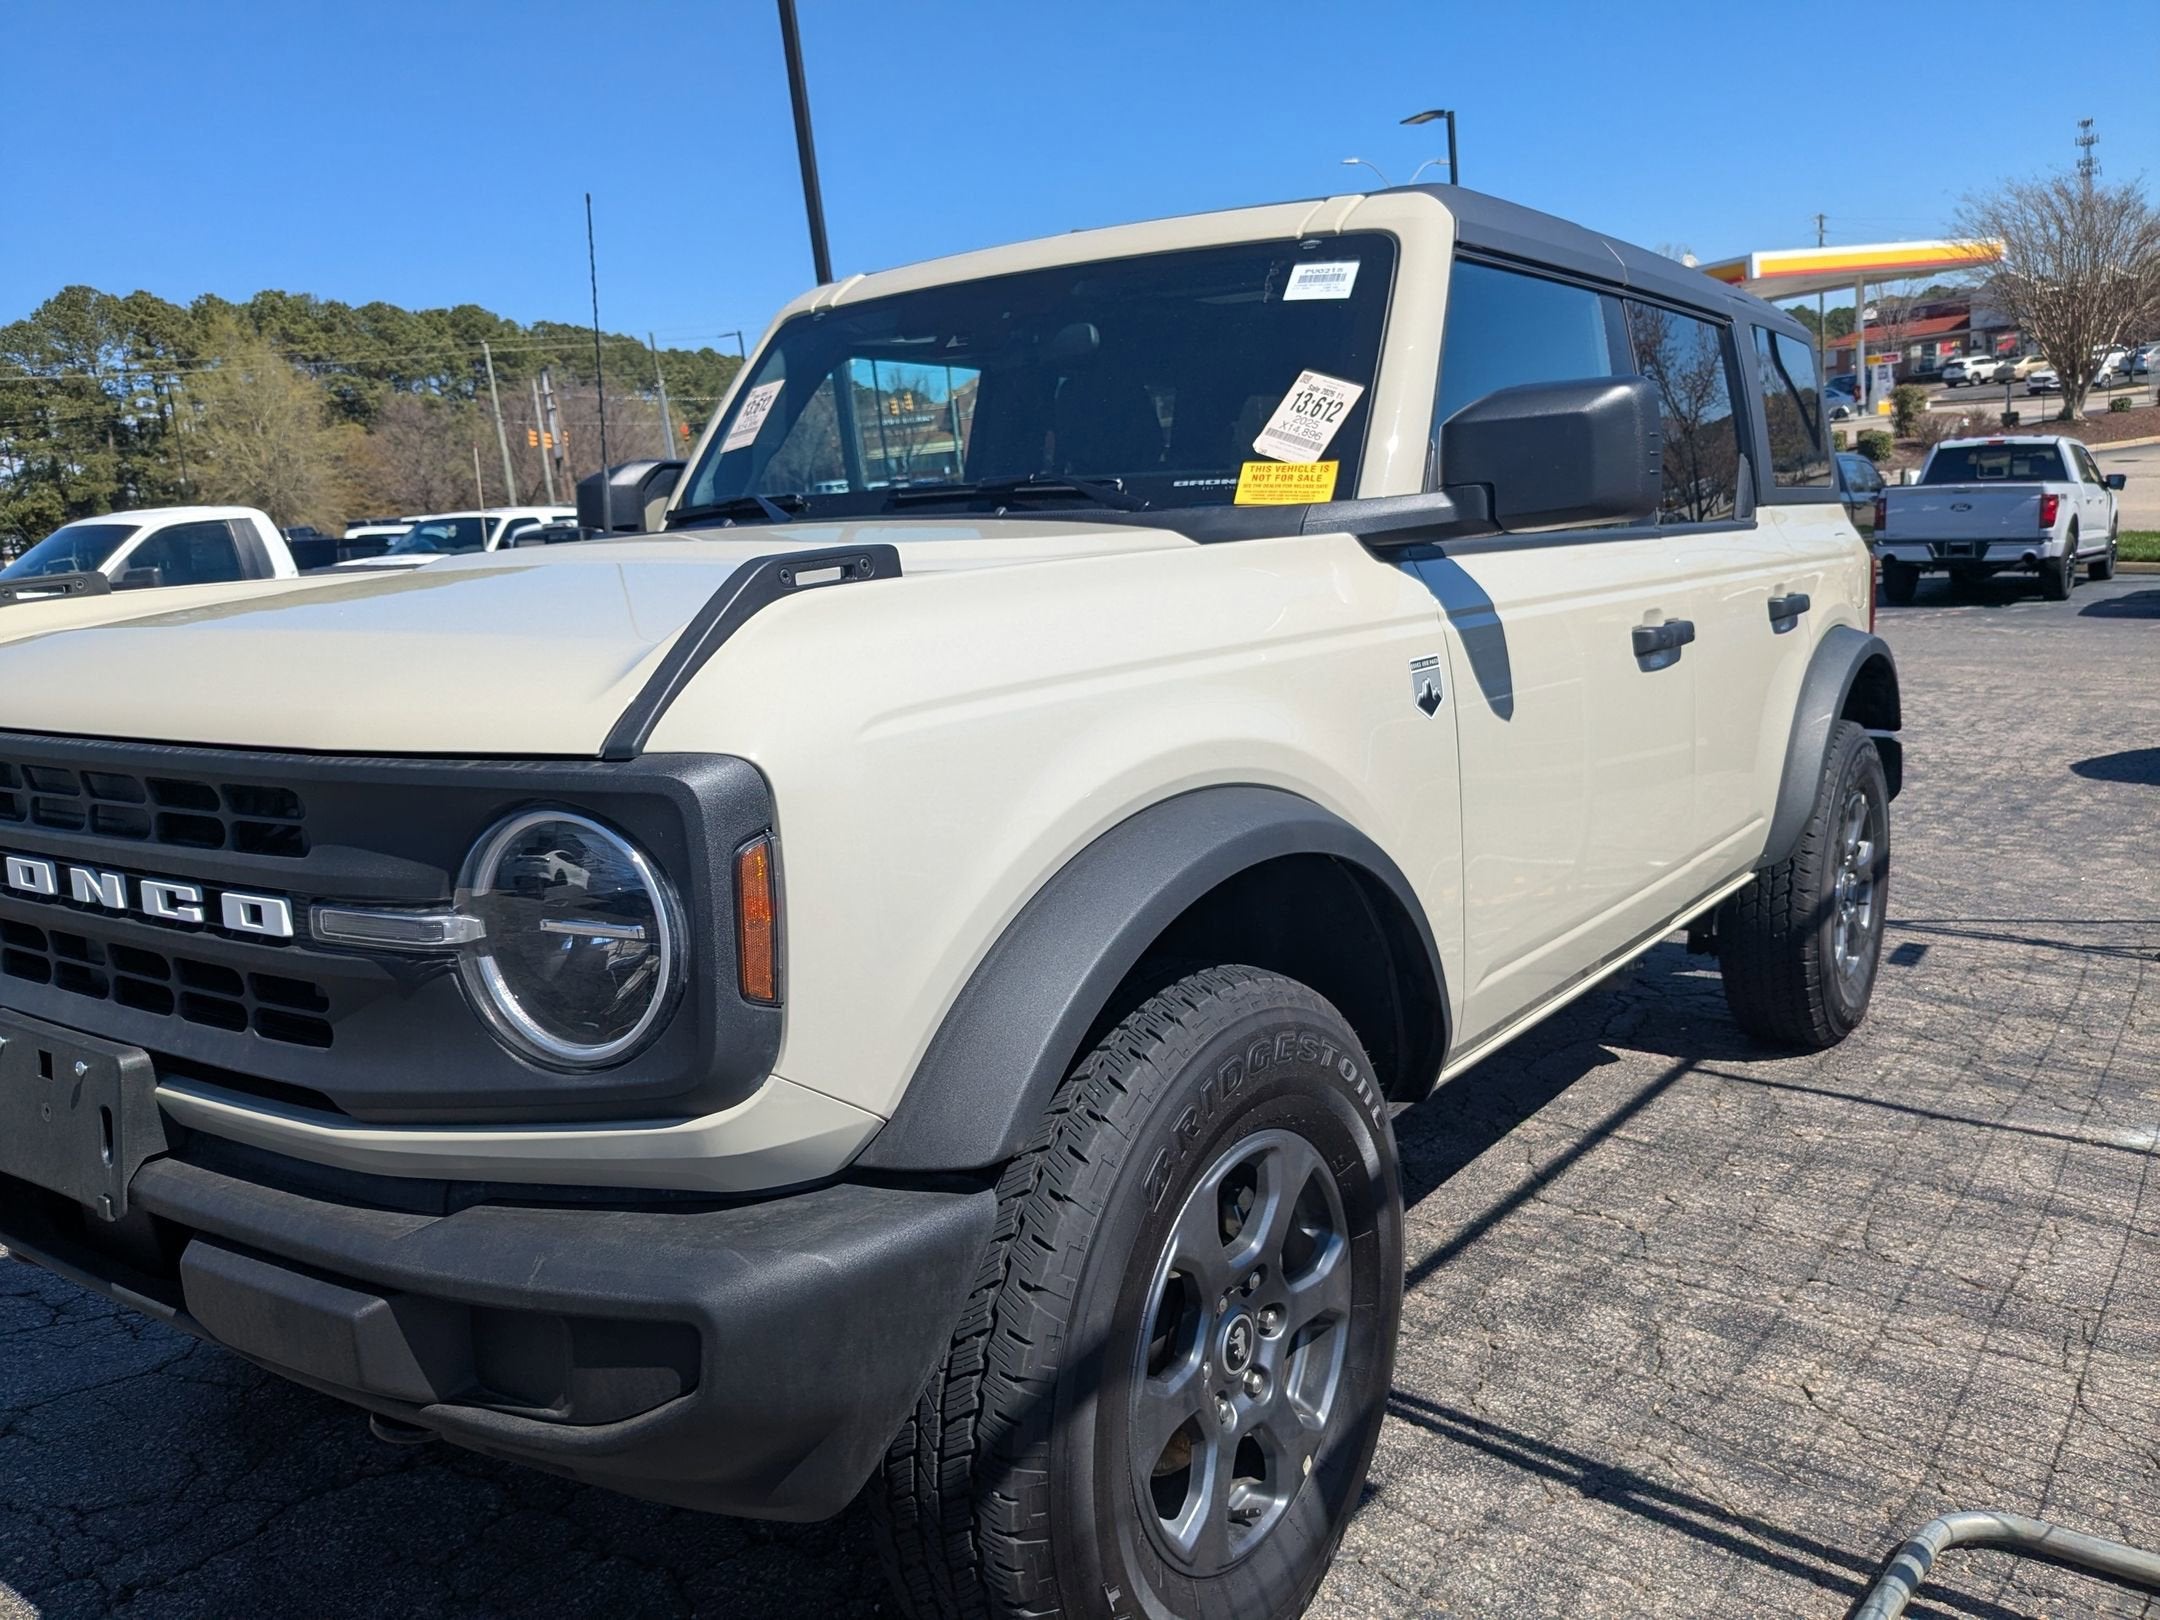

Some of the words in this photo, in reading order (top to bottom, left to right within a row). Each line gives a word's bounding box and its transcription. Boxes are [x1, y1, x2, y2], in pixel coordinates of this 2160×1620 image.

[1290, 390, 1344, 423] 13:612
[1293, 415, 1320, 429] 2025
[1250, 465, 1272, 473] THIS
[1275, 464, 1317, 473] VEHICLE
[1320, 464, 1330, 472] IS
[1251, 474, 1272, 482] NOT
[1275, 474, 1293, 482] FOR
[1297, 474, 1323, 482] SALE
[1143, 1030, 1388, 1214] BRIDGESTONE
